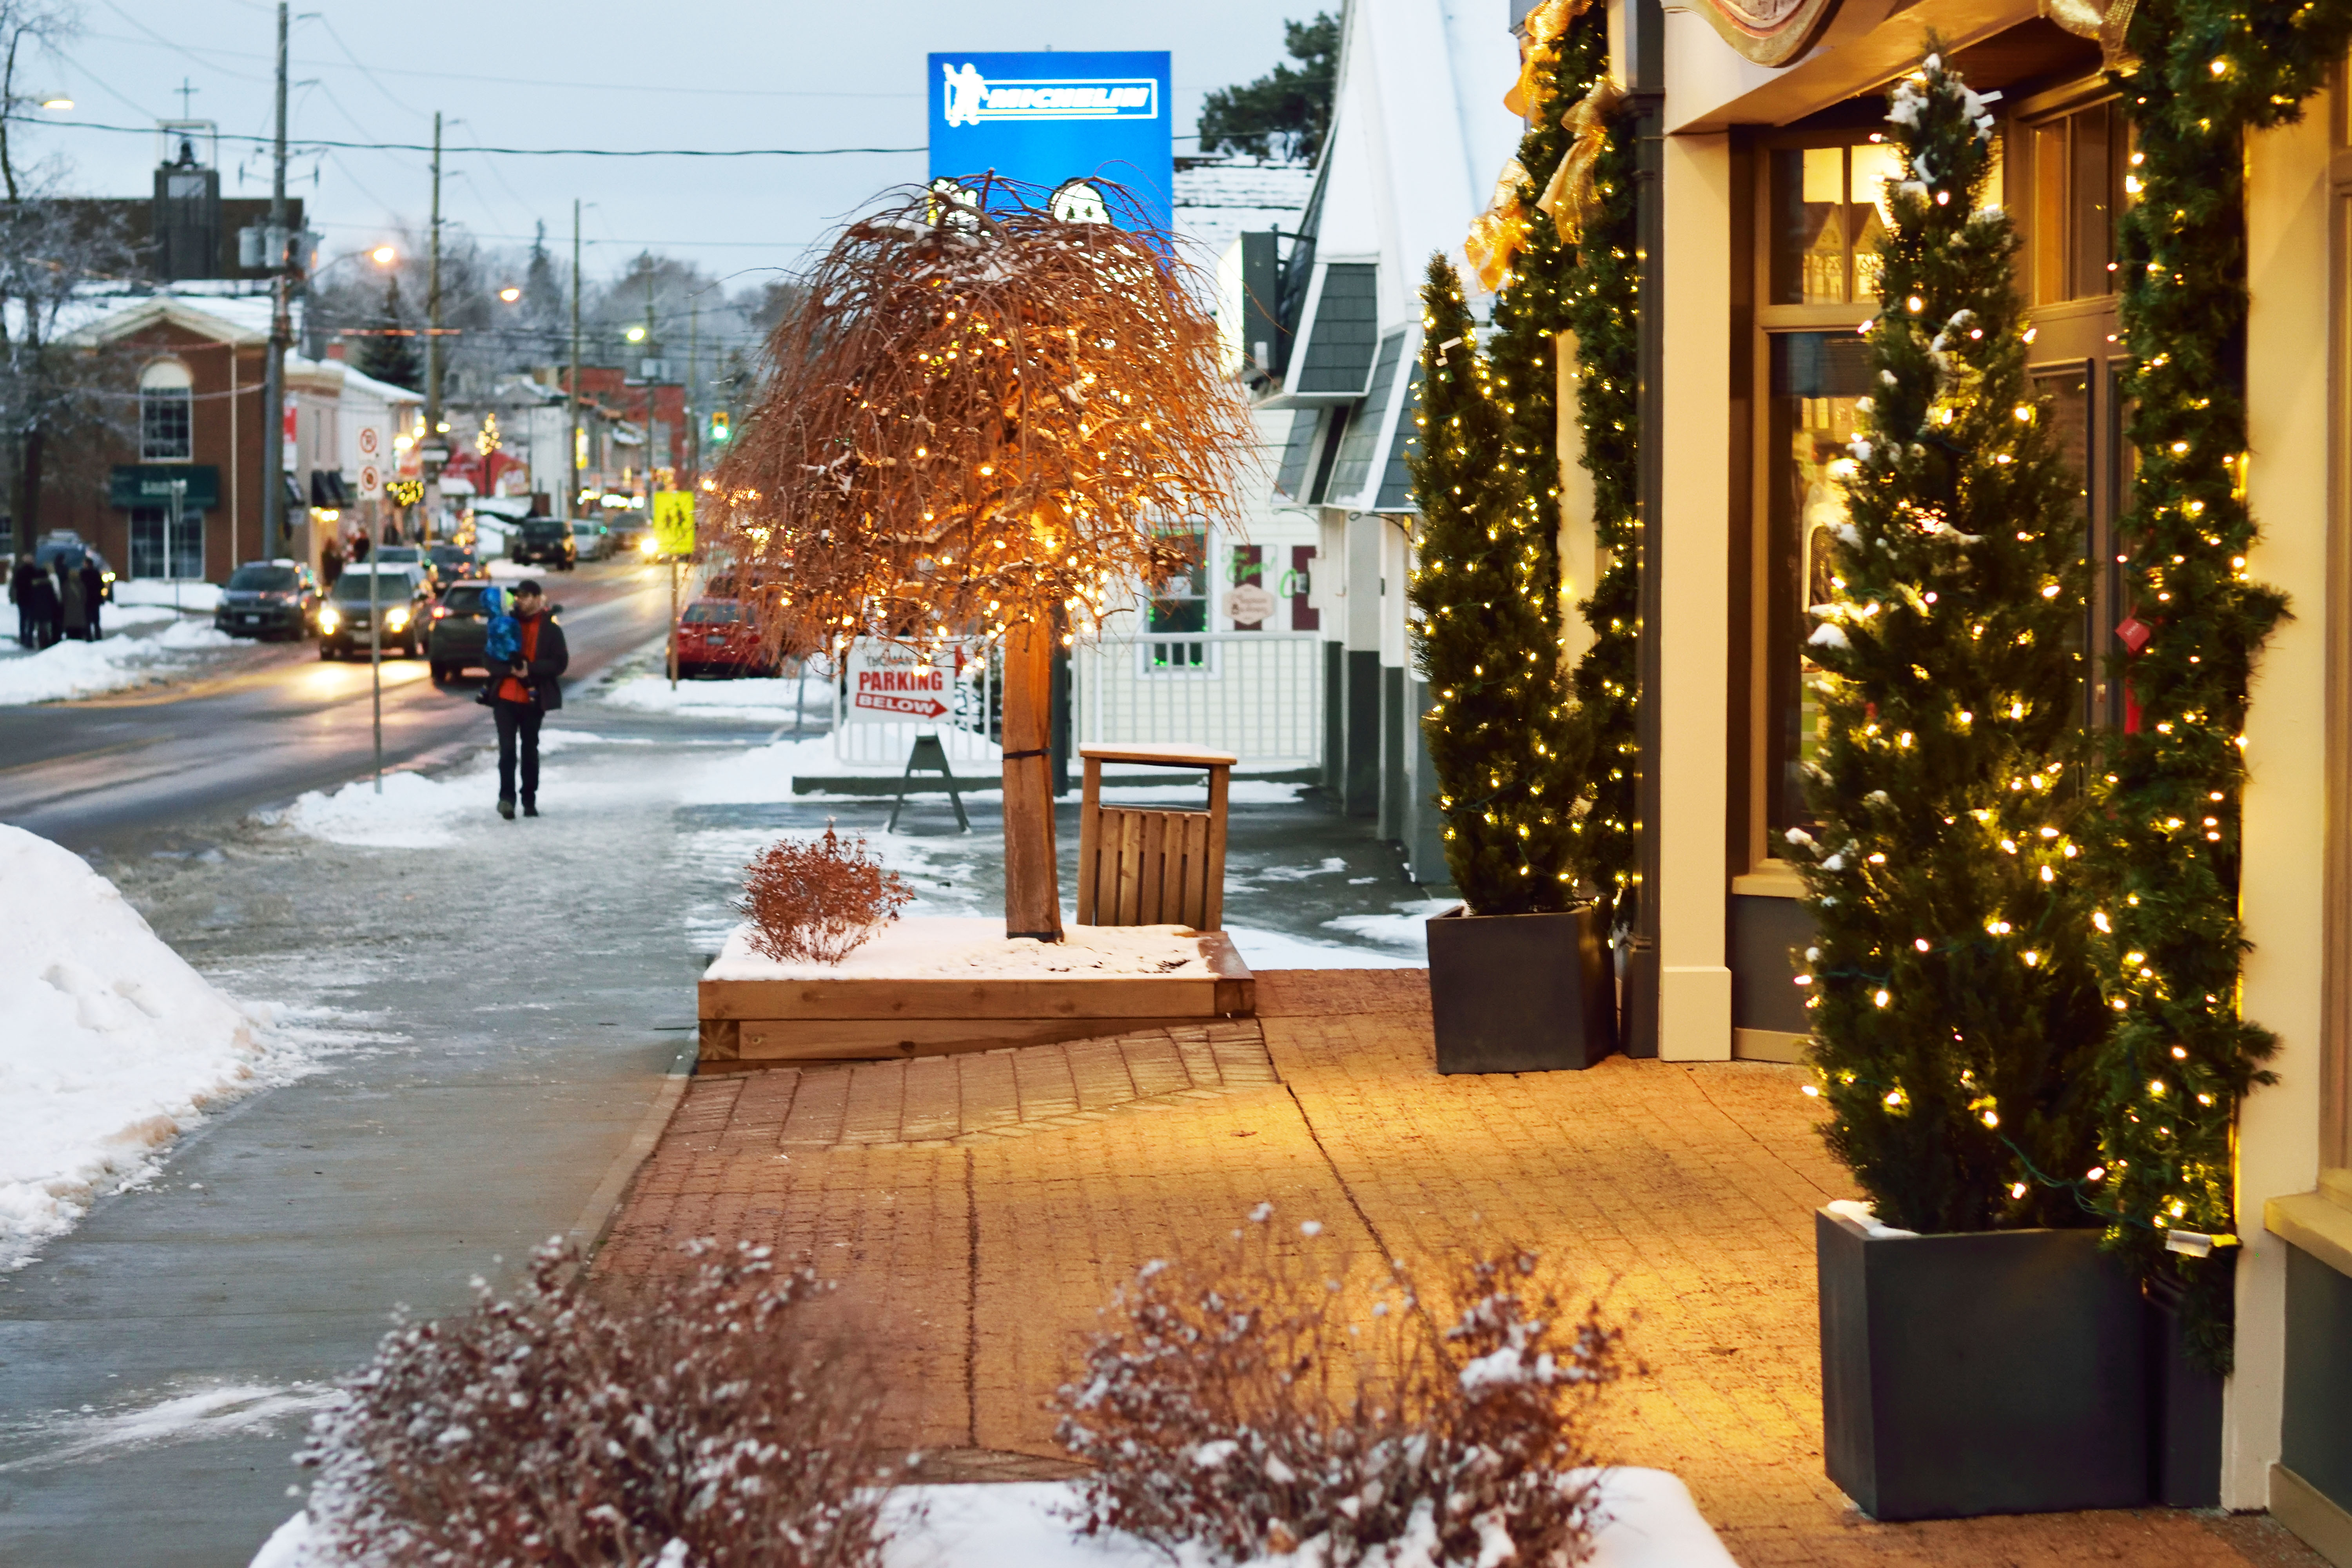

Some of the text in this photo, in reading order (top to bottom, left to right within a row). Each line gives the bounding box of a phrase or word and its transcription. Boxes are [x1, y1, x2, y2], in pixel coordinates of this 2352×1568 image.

[987, 88, 1149, 108] MICHELIN
[859, 671, 943, 691] PARKING
[859, 695, 935, 713] BELOW
